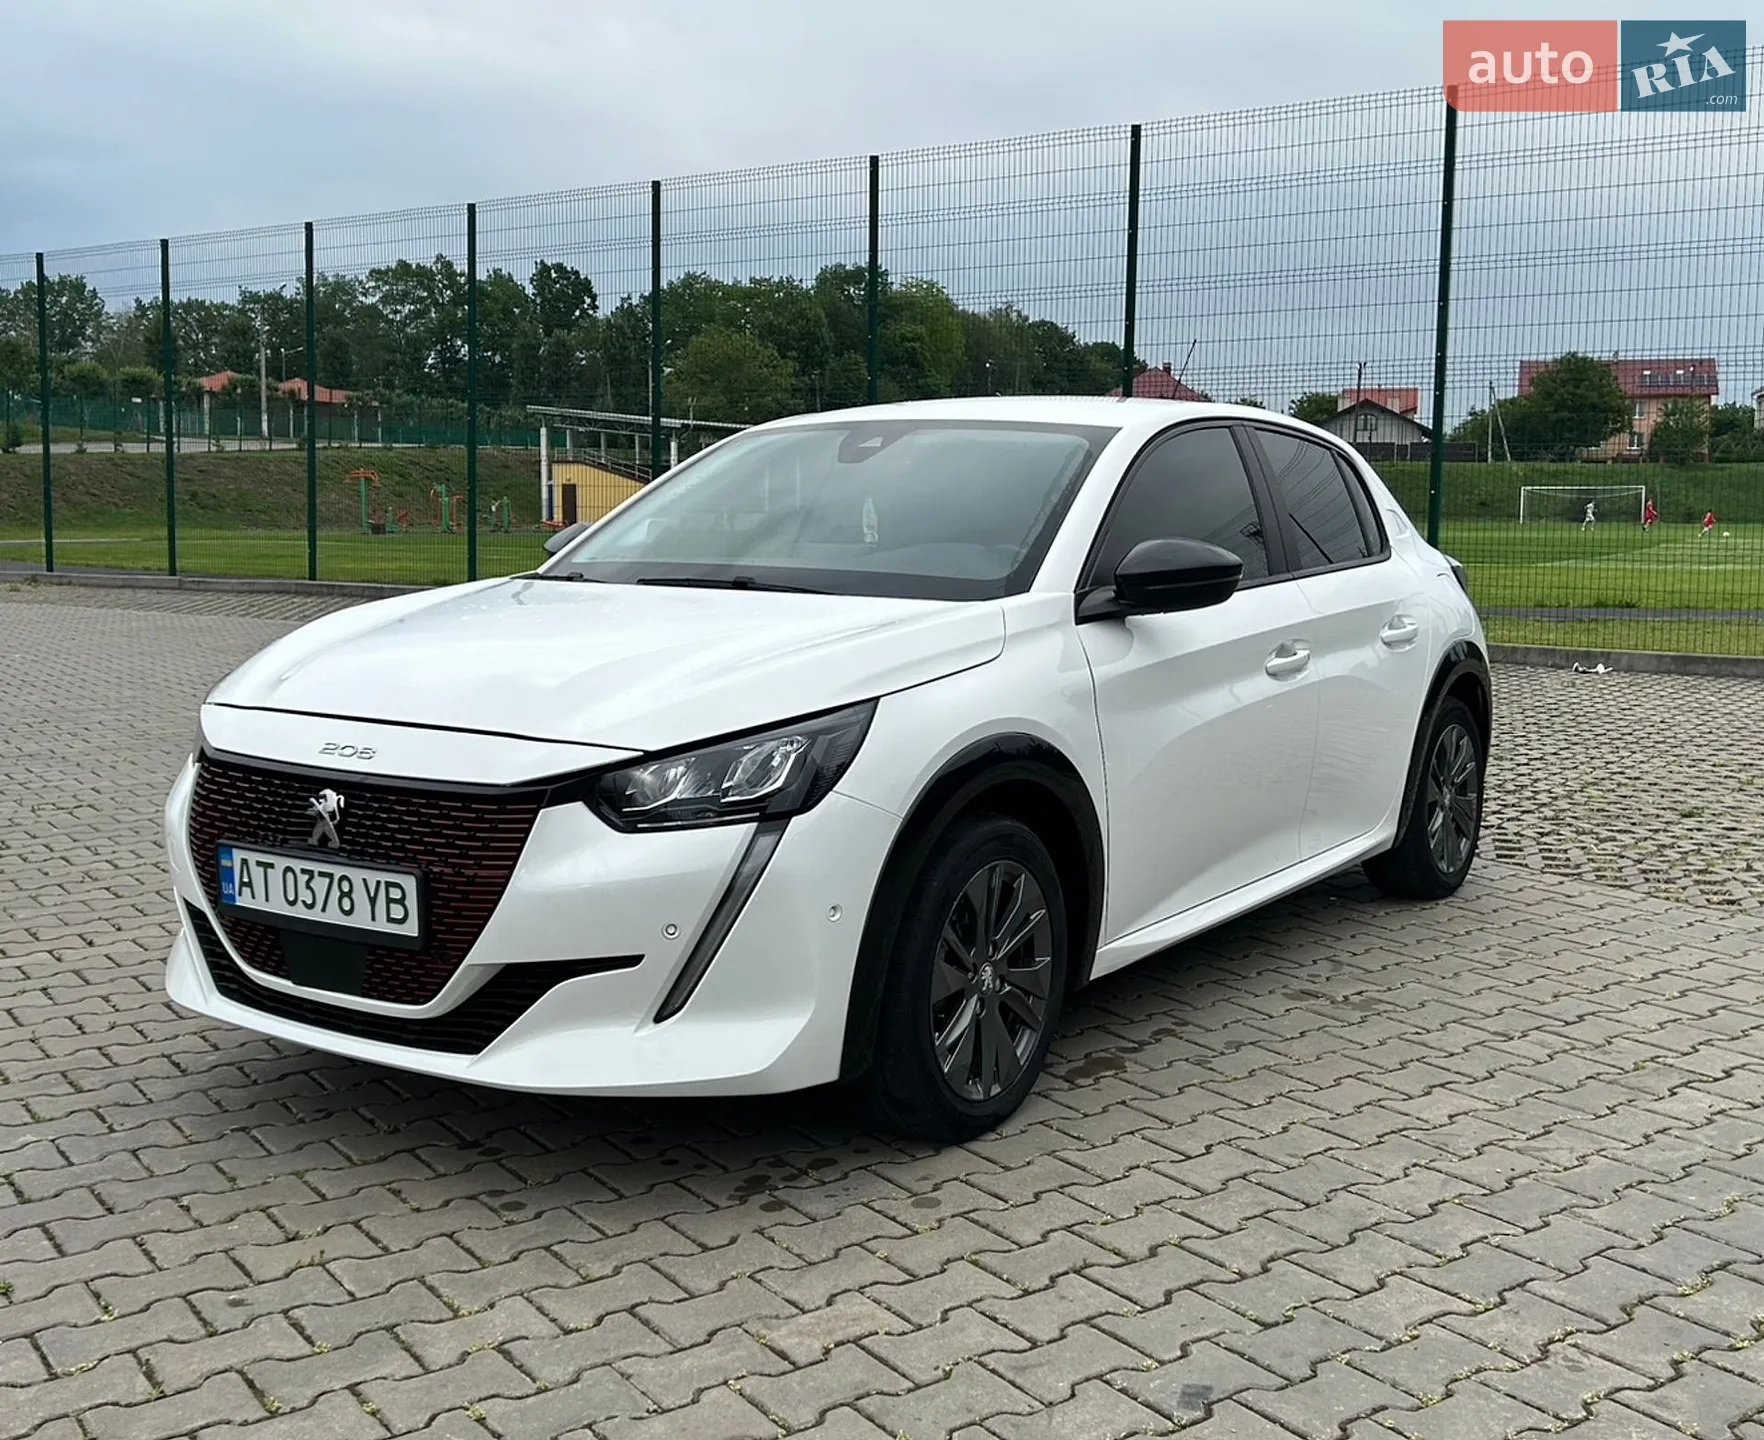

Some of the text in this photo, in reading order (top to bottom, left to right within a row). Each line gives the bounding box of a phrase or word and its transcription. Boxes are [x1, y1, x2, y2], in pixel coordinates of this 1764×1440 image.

[319, 742, 377, 760] 208
[222, 883, 235, 895] UA
[238, 858, 409, 925] AT 0378 YB
